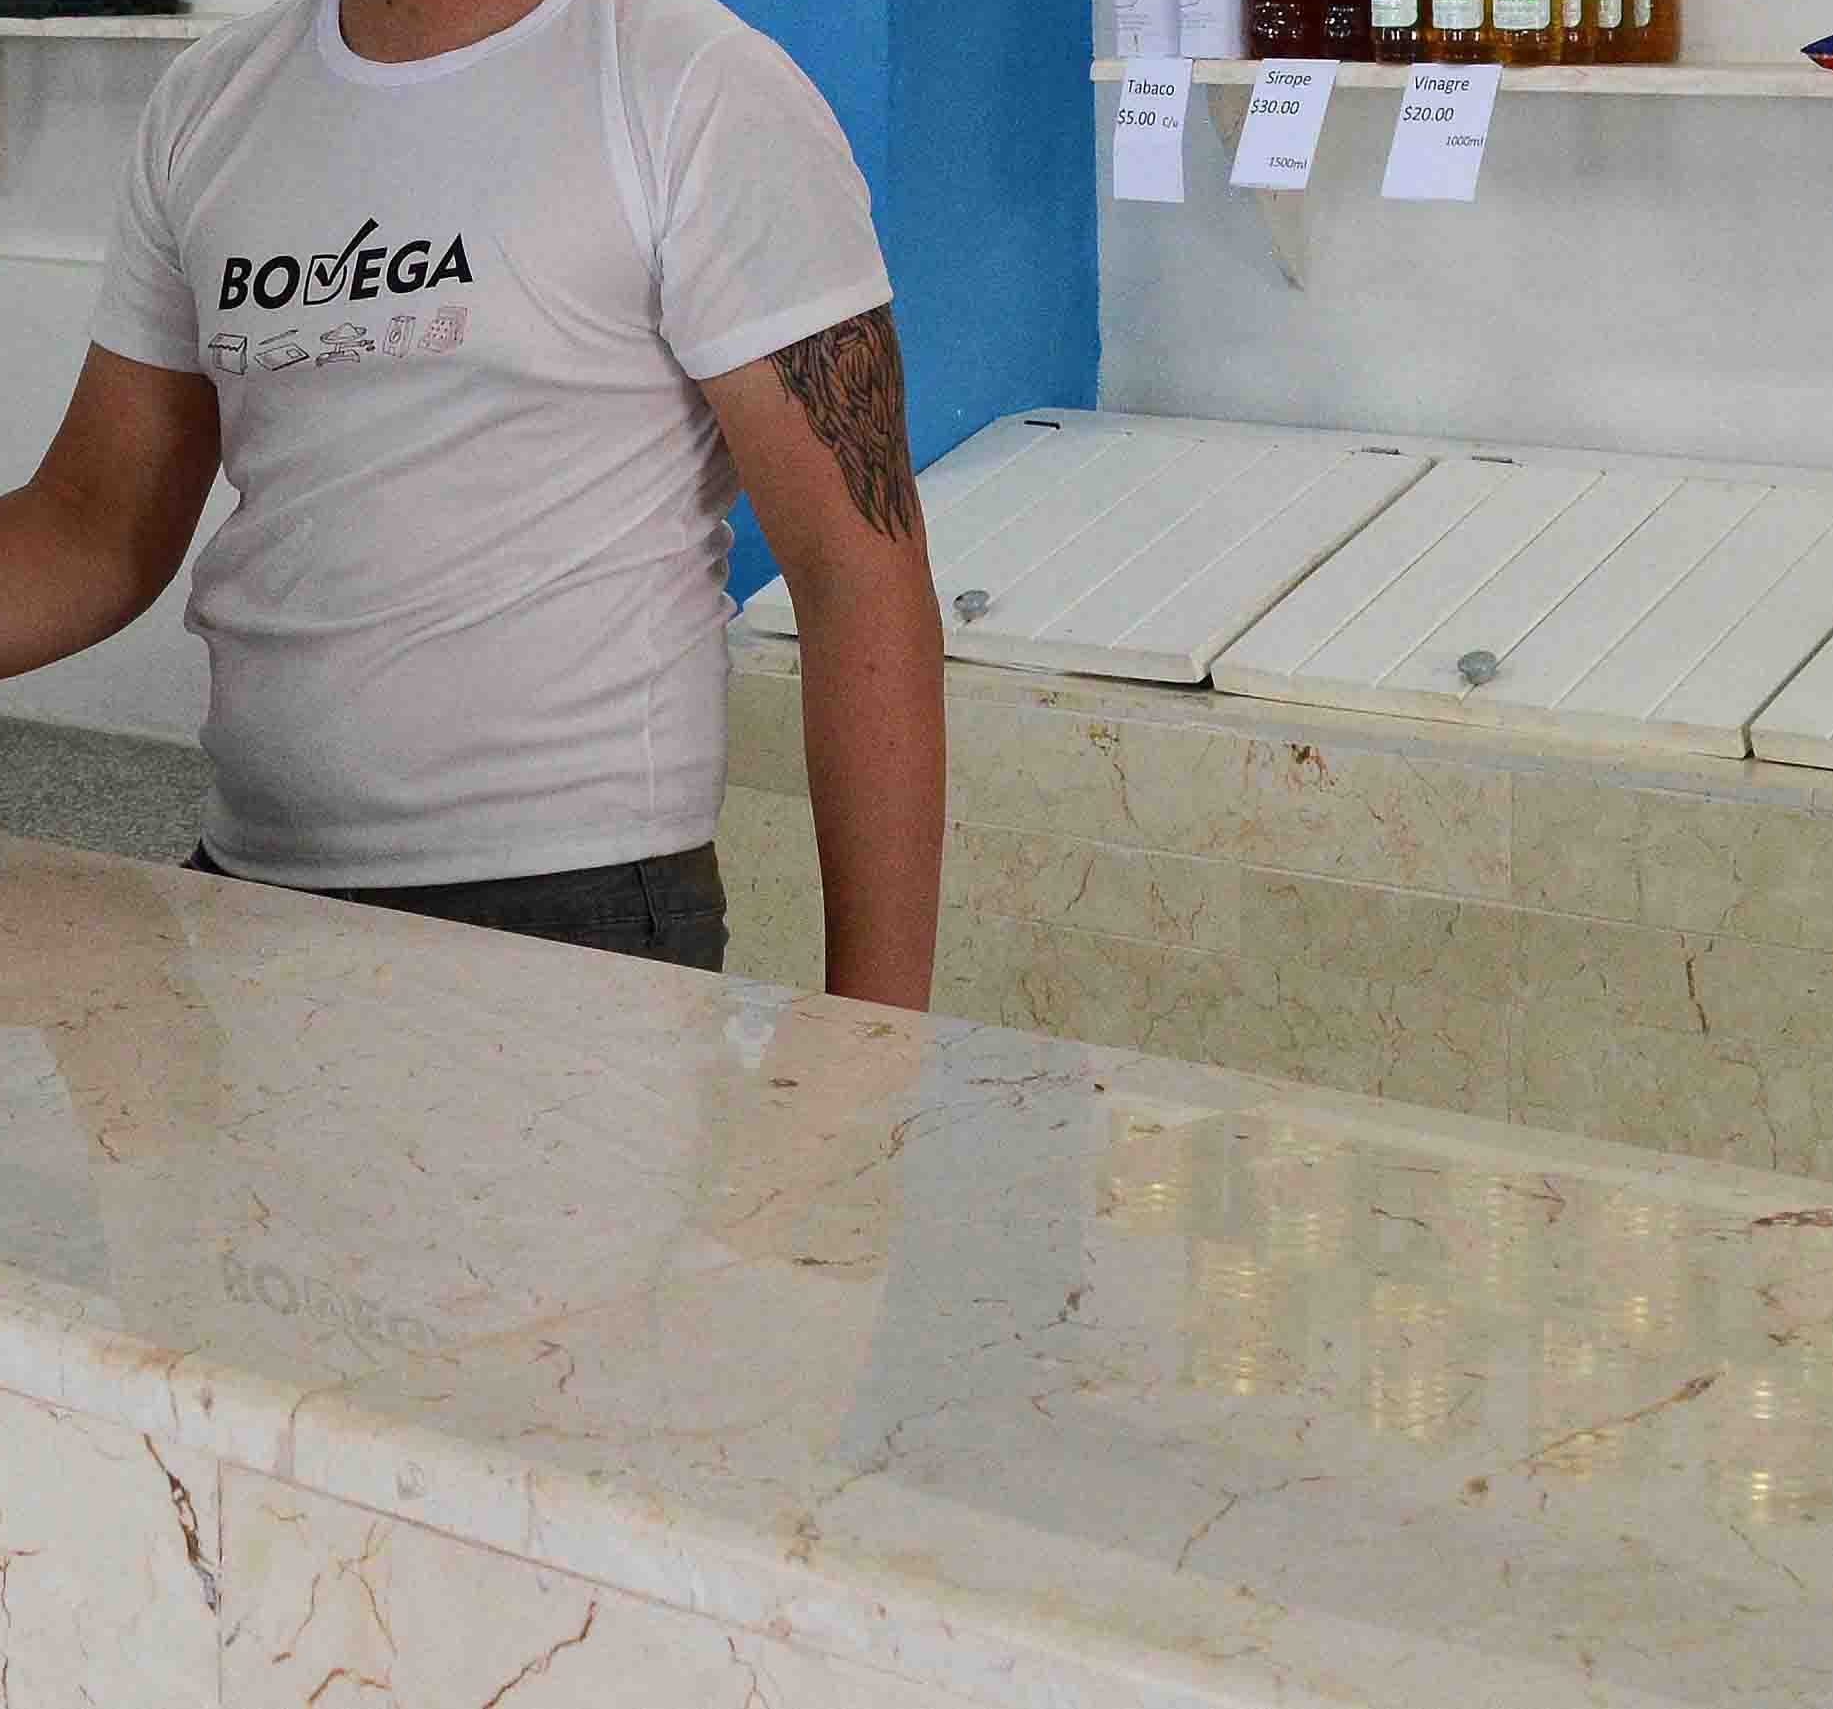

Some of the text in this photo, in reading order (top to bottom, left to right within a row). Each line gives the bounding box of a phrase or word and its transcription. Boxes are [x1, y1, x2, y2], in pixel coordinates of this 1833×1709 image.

[1127, 79, 1175, 96] Tabaco
[1265, 71, 1312, 88] Sirope
[1414, 76, 1470, 94] Vinagre
[1250, 99, 1300, 115] $30.00
[1403, 106, 1454, 122] $20.00
[1118, 109, 1156, 126] $5.00
[1445, 135, 1484, 148] 1000ml
[1268, 157, 1308, 170] 1500ml
[218, 218, 474, 311] BODEGA
